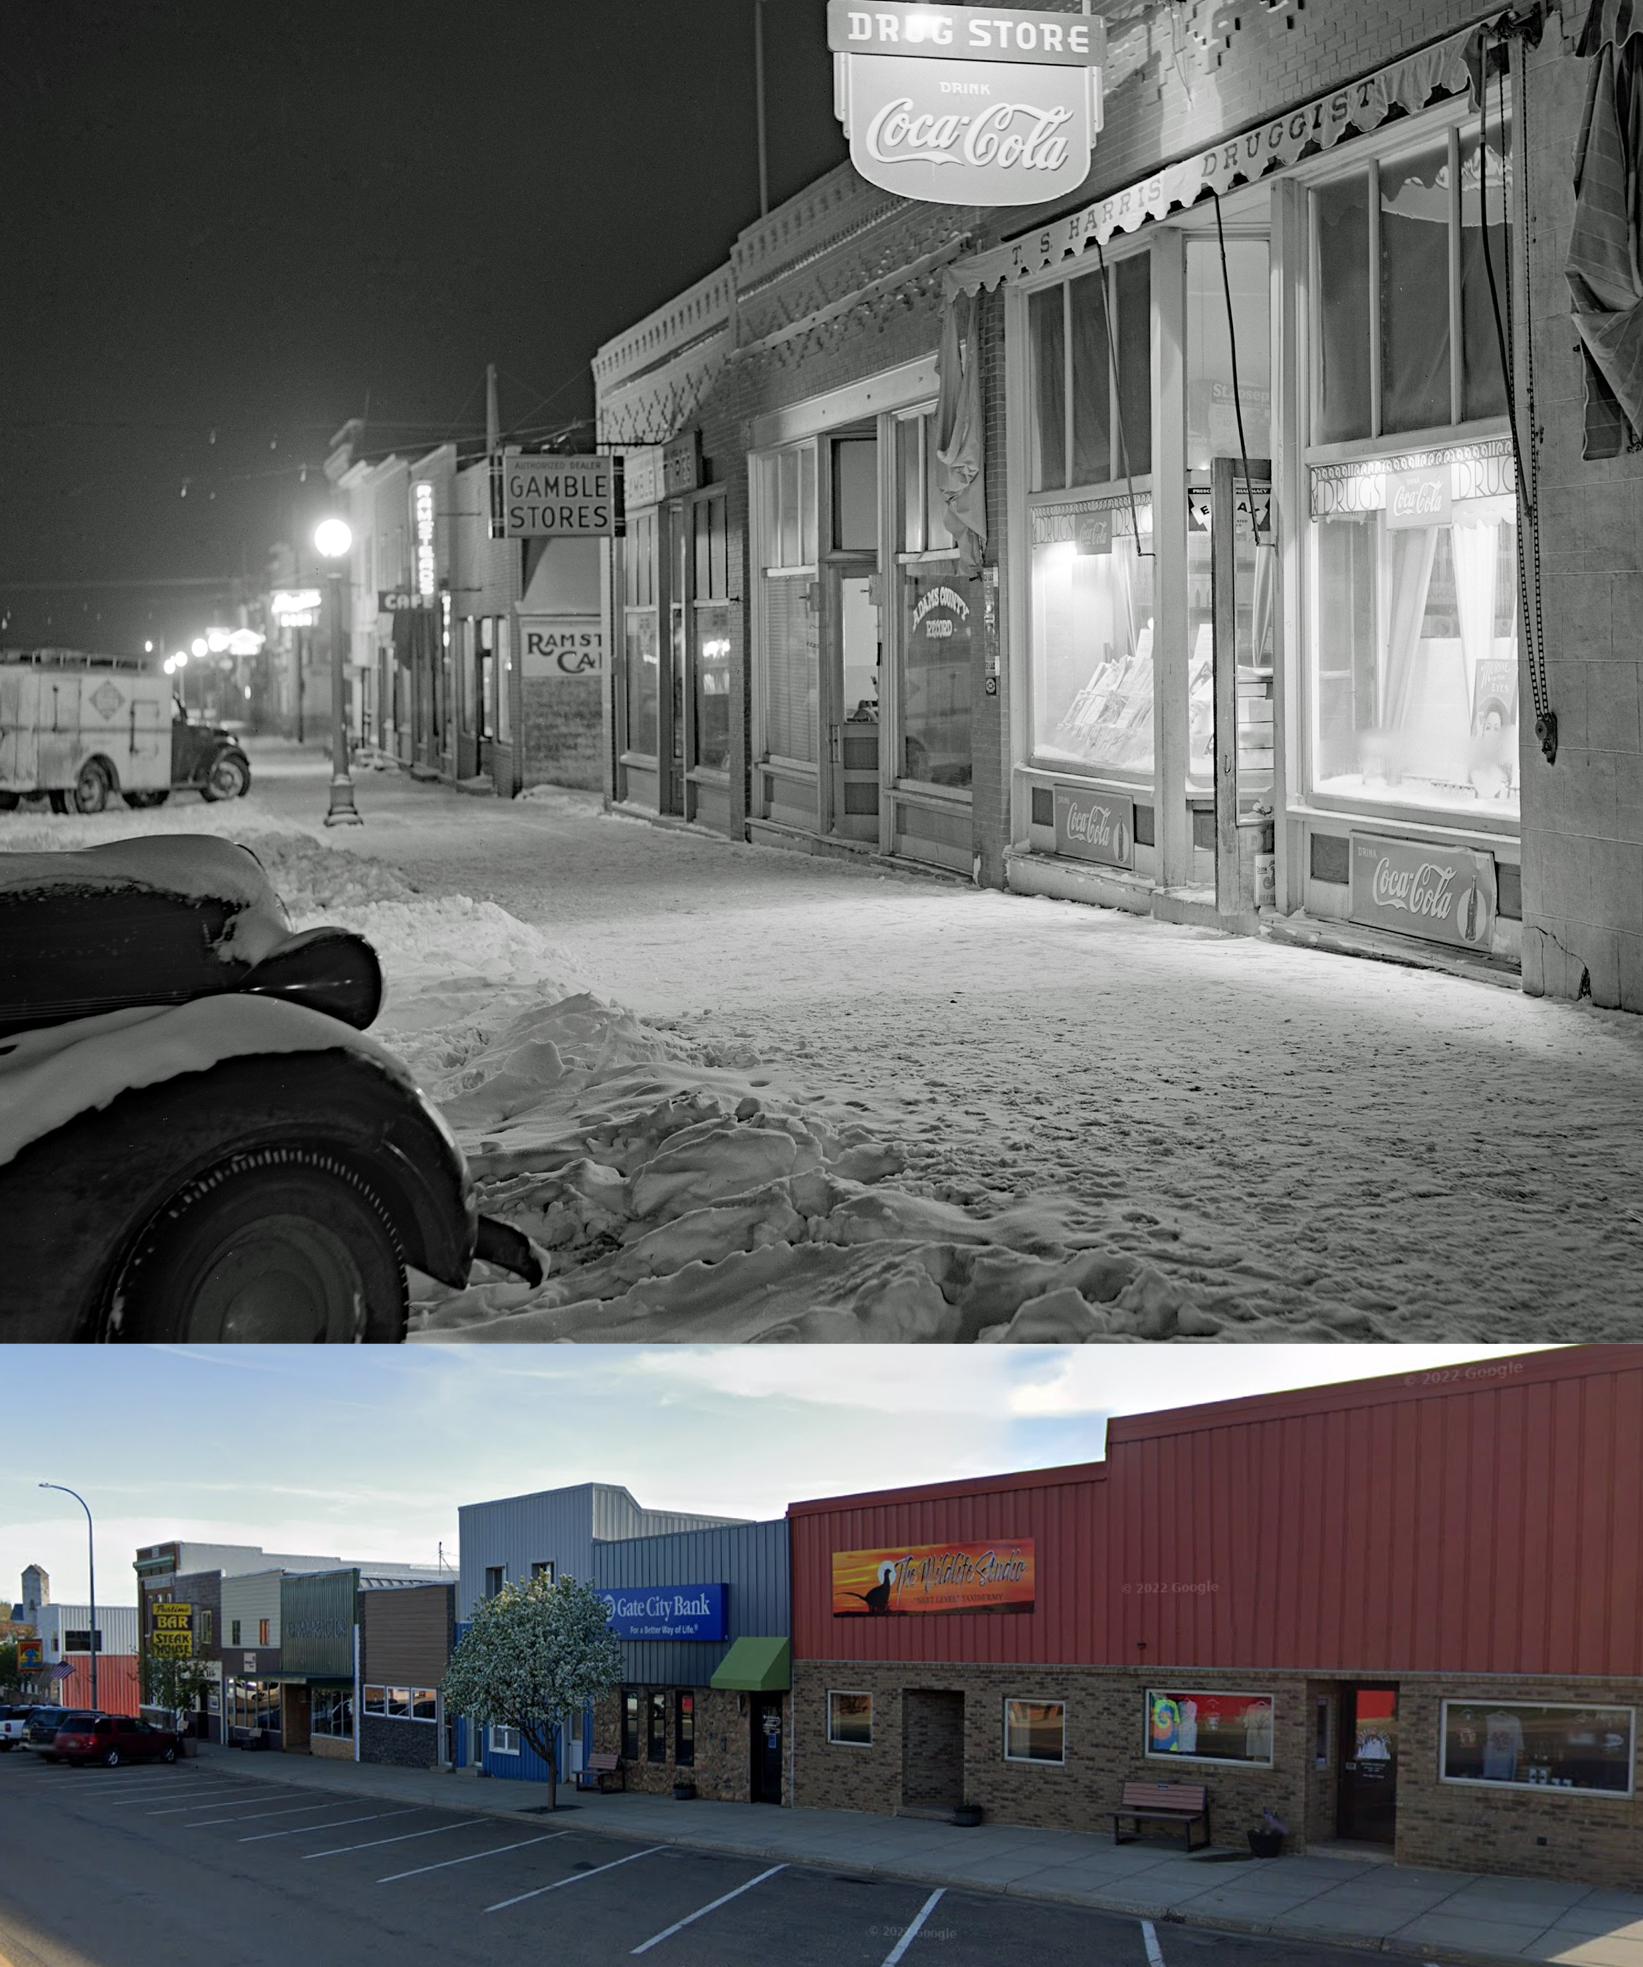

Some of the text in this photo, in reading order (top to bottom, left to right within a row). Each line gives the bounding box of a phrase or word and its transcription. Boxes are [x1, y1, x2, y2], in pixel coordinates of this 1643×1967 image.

[848, 12, 1090, 53] DRUG STORE
[939, 81, 991, 96] DRINK
[866, 97, 1075, 171] Coca-Cola
[1068, 177, 1163, 240] HARRIS
[1201, 78, 1376, 178] DRUGGIST
[510, 475, 608, 498] GAMBLE
[510, 505, 609, 529] STORES
[557, 650, 602, 675] CA
[1372, 856, 1457, 920] Coca-Cola
[895, 1548, 1026, 1592] The Wildlife Studio
[617, 1592, 711, 1622] Gate City Bank
[157, 1616, 189, 1629] BAR
[630, 1625, 639, 1634] For
[644, 1625, 661, 1634] Better
[661, 1625, 674, 1636] Way
[155, 1633, 190, 1644] STEAK
